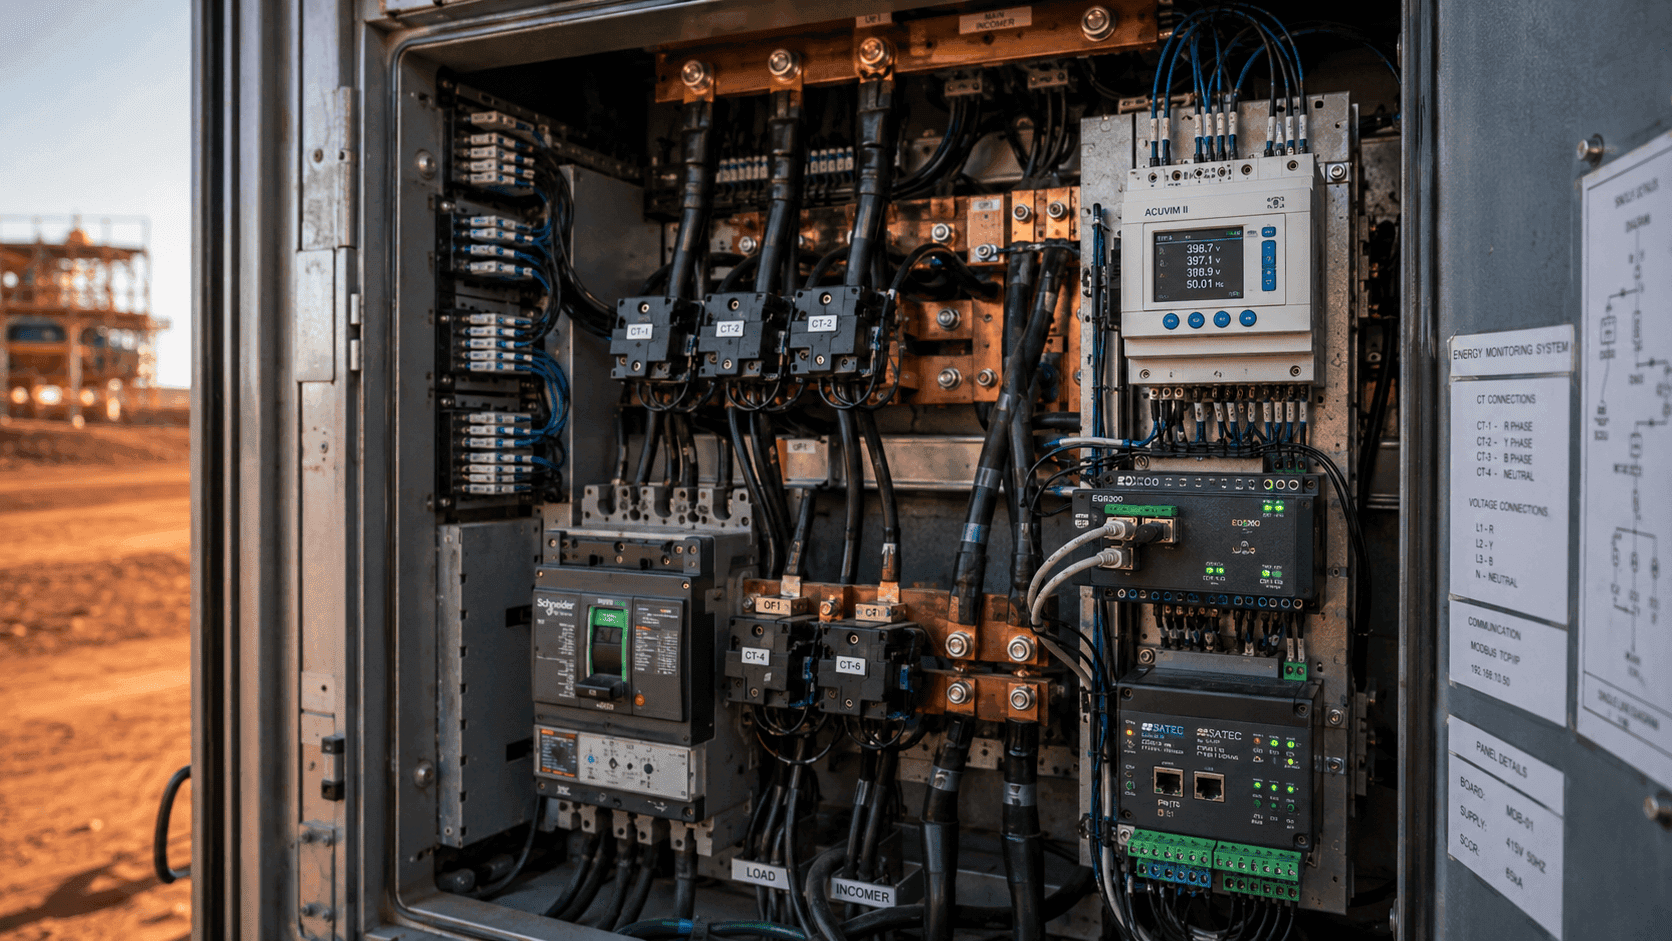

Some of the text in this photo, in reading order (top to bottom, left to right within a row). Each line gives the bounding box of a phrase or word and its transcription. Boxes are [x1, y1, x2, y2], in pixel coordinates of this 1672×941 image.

[1144, 206, 1180, 216] ACUVIM
[1187, 243, 1213, 253] 398.7
[1187, 255, 1212, 265] 397.1
[720, 323, 740, 334] CT-2
[812, 319, 832, 328] CT-2
[631, 327, 648, 335] CT-1
[1453, 341, 1569, 360] ENERGY MONITORING SYSTEM
[1477, 394, 1536, 404] CT CONNECTIONS
[1477, 421, 1491, 430] CT-1
[1504, 421, 1509, 430] R
[1510, 421, 1533, 432] PHASE
[1477, 436, 1491, 446] CT-2
[1504, 438, 1508, 447] Y
[1510, 437, 1533, 449] PHASE
[1477, 451, 1491, 461] CT-3
[1504, 453, 1508, 463] B
[1510, 453, 1533, 465] PHASE
[1477, 467, 1491, 476] CT-4
[1504, 469, 1534, 481] NEUTRAL
[1469, 498, 1548, 517] VOLTAGE CONNECTIONS
[1476, 523, 1483, 532] L1
[1489, 524, 1494, 534] R
[1476, 538, 1483, 548] L2
[1489, 540, 1493, 550] Y
[1476, 554, 1483, 564] L3
[1489, 556, 1493, 566] B
[1476, 569, 1481, 578] N
[1488, 572, 1518, 588] NEUTRAL
[1468, 616, 1521, 640] COMMUNICATION
[1471, 640, 1497, 658] MODBUS
[745, 651, 765, 661] CT-4
[1153, 723, 1184, 735] SATEC
[1209, 728, 1242, 740] SATEC
[1476, 740, 1528, 778] PANEL DETAILS
[1460, 776, 1486, 801] BOARD:
[1460, 805, 1487, 832] SUPPLY:
[746, 867, 776, 881] LOAD
[836, 883, 890, 903] INCOMER
